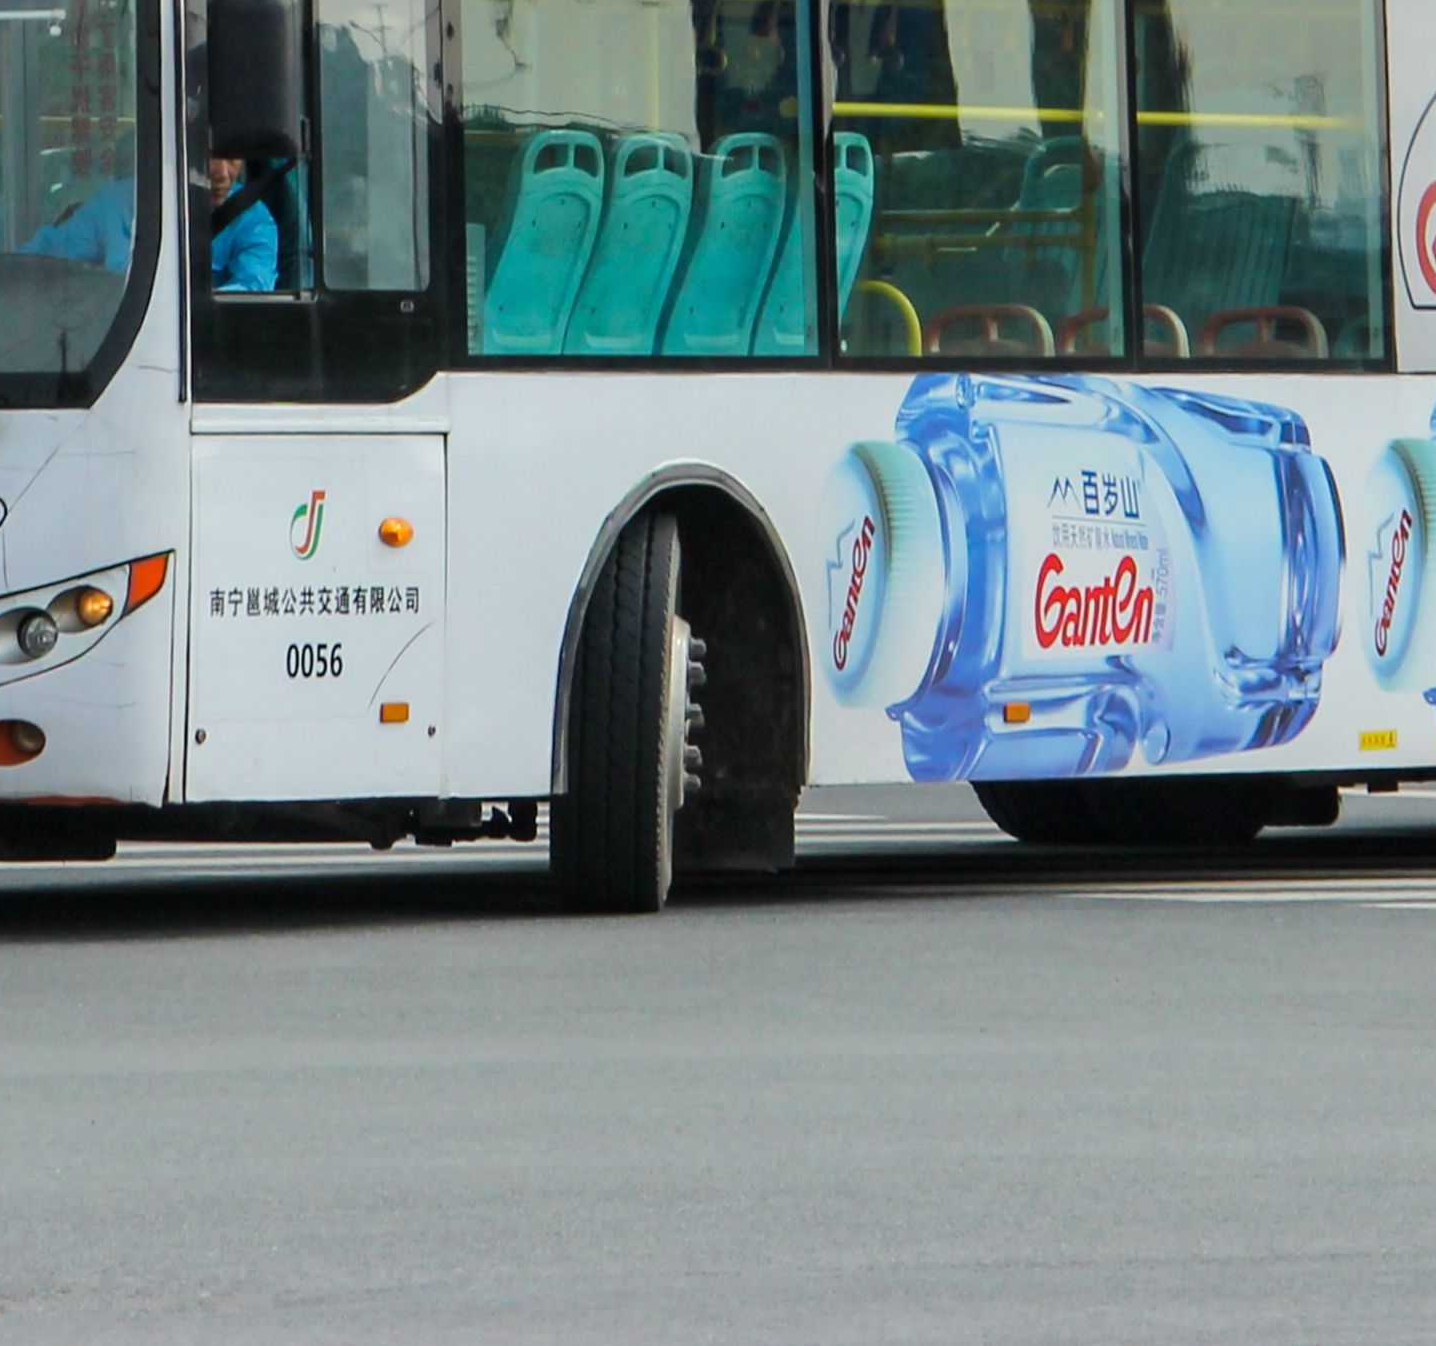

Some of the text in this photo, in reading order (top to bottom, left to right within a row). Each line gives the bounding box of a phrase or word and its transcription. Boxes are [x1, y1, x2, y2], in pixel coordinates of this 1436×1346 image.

[1081, 470, 1140, 519] 百岁山
[210, 586, 420, 616] 南宁邕城公共交通有限公司
[833, 516, 875, 671] Ganten
[1035, 553, 1153, 649] Ganten
[286, 643, 343, 678] 0056
